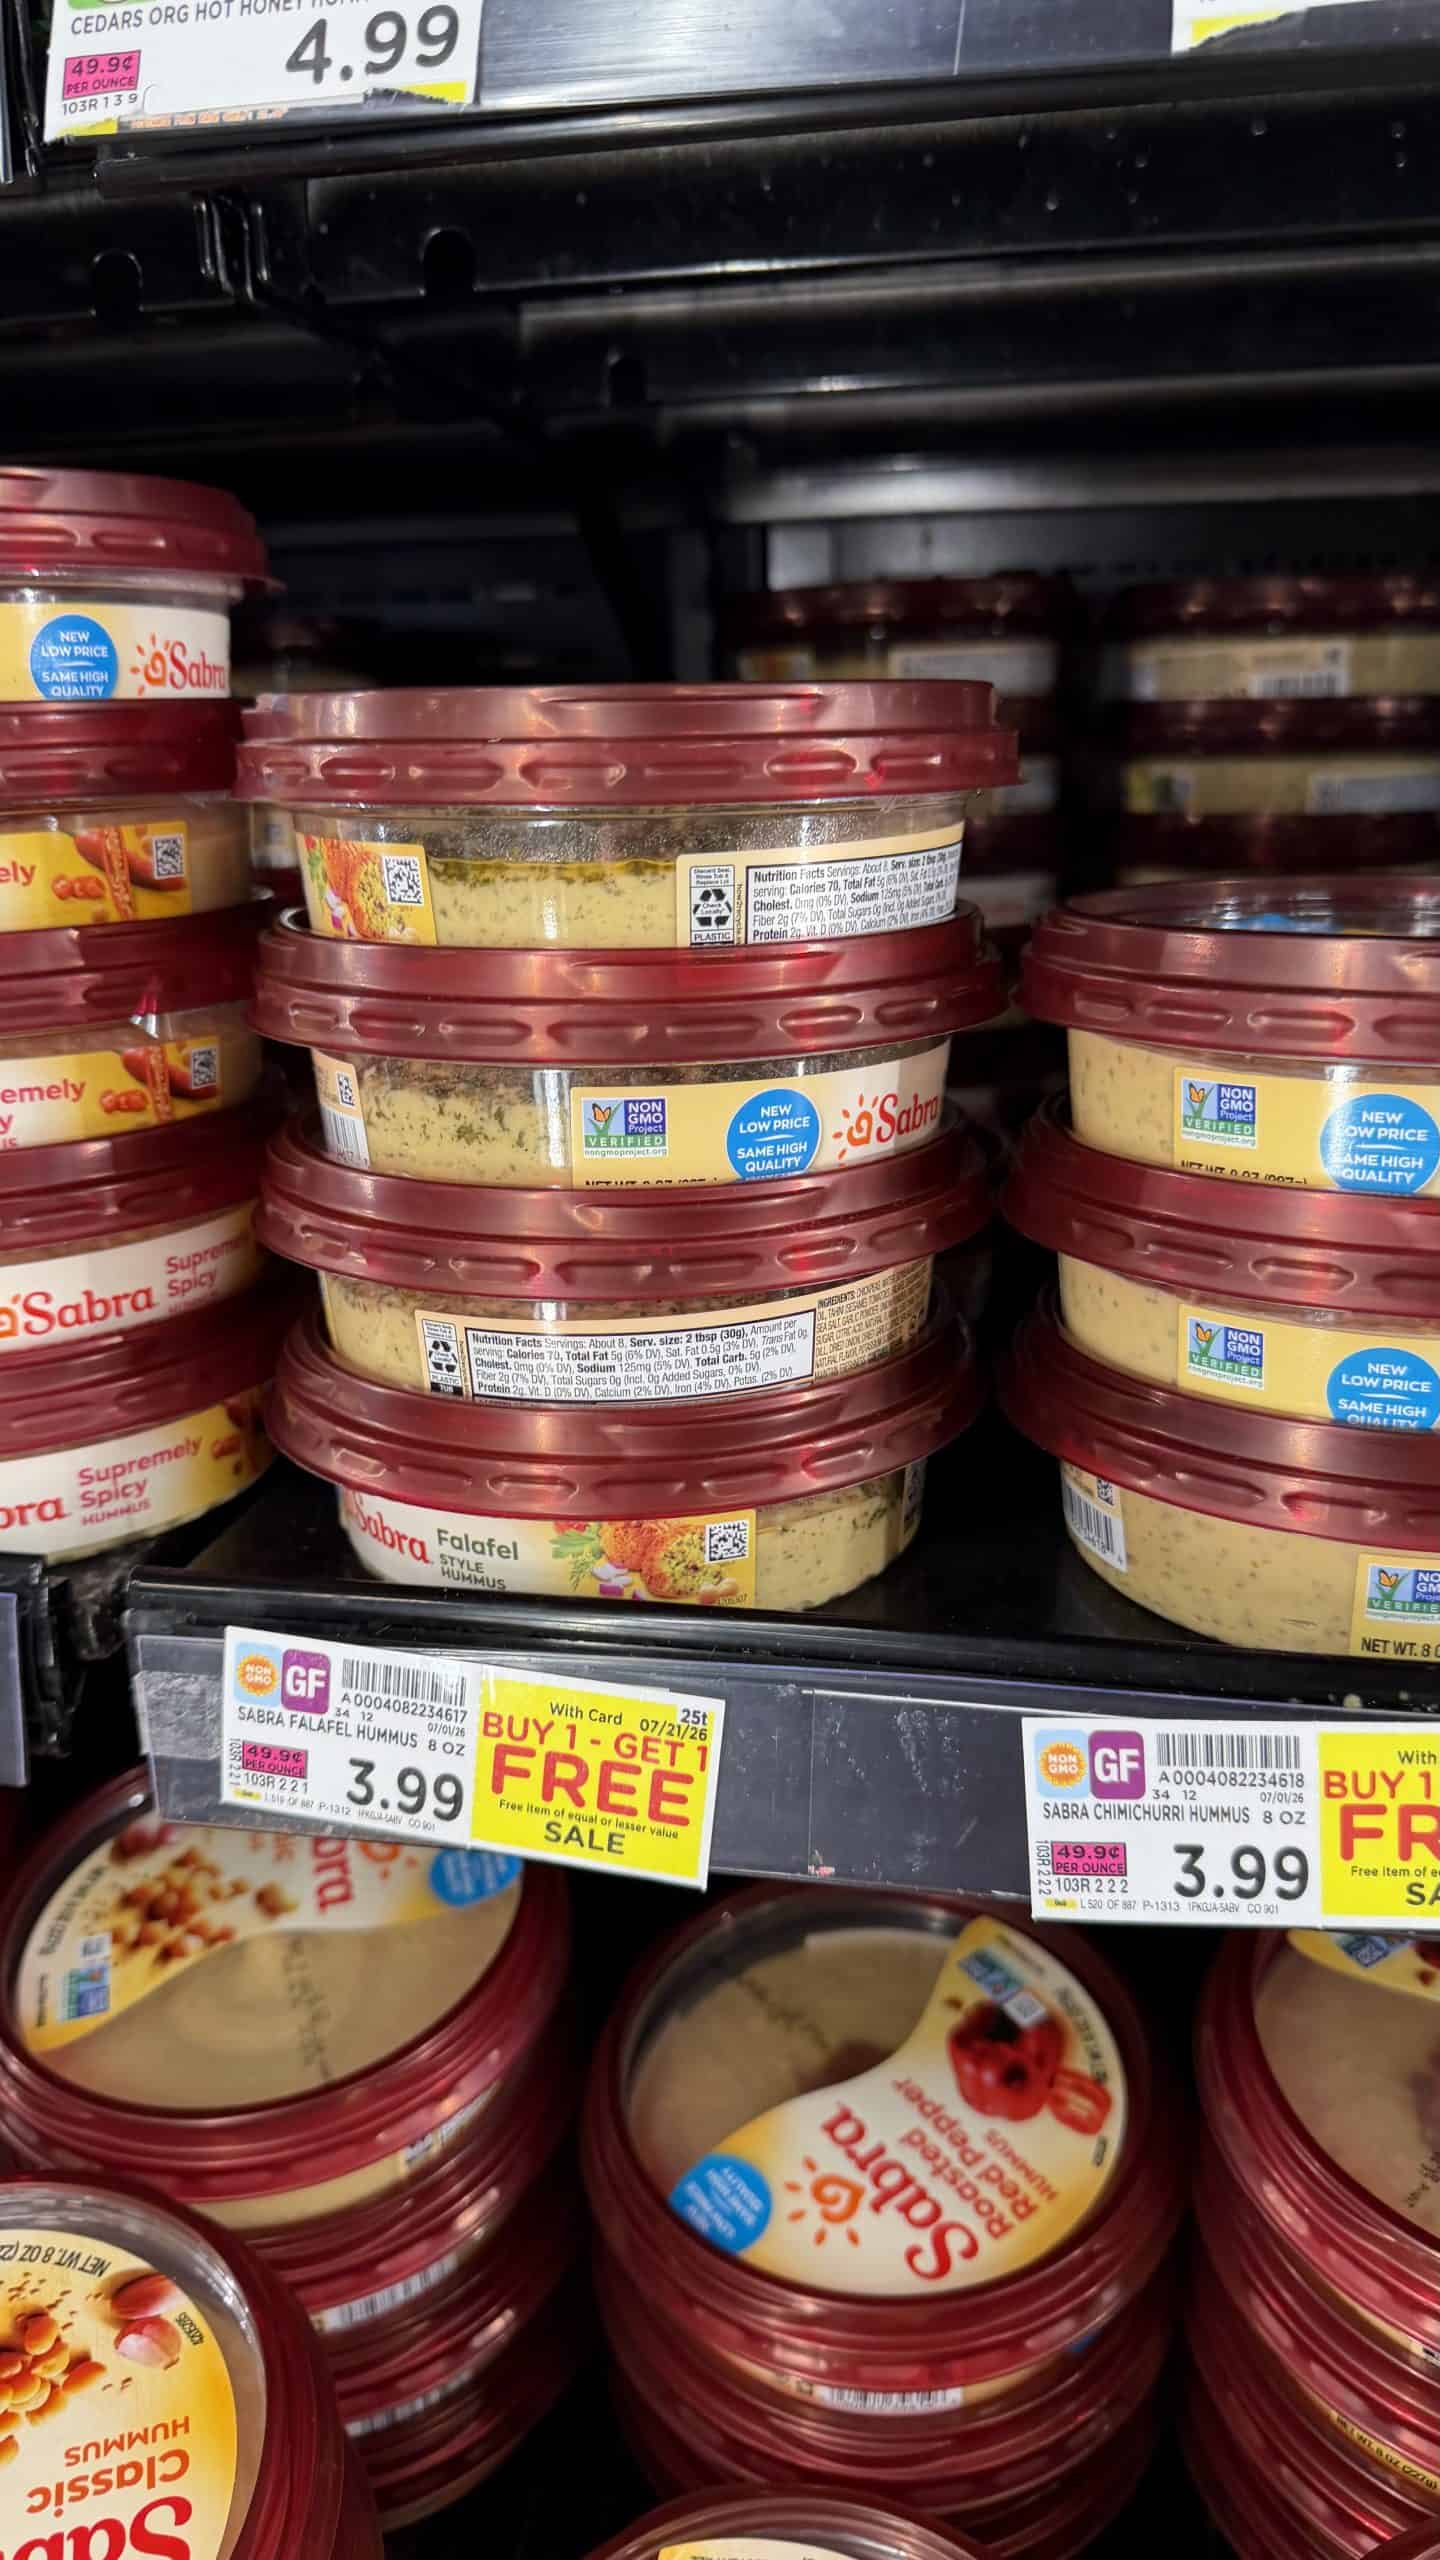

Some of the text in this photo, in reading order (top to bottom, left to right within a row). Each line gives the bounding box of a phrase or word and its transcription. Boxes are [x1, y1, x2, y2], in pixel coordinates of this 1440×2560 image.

[71, 10, 143, 35] CEDARS
[150, 5, 189, 25] ORG
[195, 0, 232, 21] HOT
[286, 5, 459, 85] 4.99
[72, 56, 133, 77] 49.9¢
[67, 76, 136, 95] PER OUNCE
[64, 98, 98, 115] 103R
[60, 631, 90, 643] NEW
[41, 646, 109, 657] LOW PRICE
[42, 671, 109, 683] SAME HIGH
[51, 685, 104, 697] QUALITY
[754, 871, 797, 883] Nutrition
[789, 882, 825, 896] Calories
[851, 891, 879, 904] Sodium
[753, 929, 788, 941] Protein
[1220, 1087, 1254, 1101] NON
[628, 1102, 662, 1112] NON
[760, 1104, 792, 1118] NEW
[1219, 1099, 1254, 1113] GMO
[628, 1113, 663, 1124] GMO
[739, 1116, 811, 1134] LOW PRICE
[1219, 1110, 1253, 1122] Project
[1362, 1111, 1403, 1124] NEW
[628, 1125, 663, 1135] Project
[1185, 1118, 1254, 1136] VERIFIED
[1377, 1127, 1429, 1142] PRICE
[589, 1135, 663, 1147] VERIFIED
[737, 1142, 808, 1160] SAME HIGH
[745, 1156, 802, 1173] QUALITY
[1381, 1154, 1424, 1169] HIGH
[1341, 1169, 1416, 1185] QUALITY
[22, 1287, 154, 1335] Sabra
[472, 1333, 542, 1348] Nutrition Facts
[1227, 1329, 1260, 1345] NON
[506, 1349, 608, 1361] Calories Total Fat
[1226, 1340, 1261, 1356] GMO
[577, 1357, 720, 1374] Sodium Total
[1191, 1354, 1261, 1378] VERIFIED
[1227, 1351, 1260, 1365] Project
[1367, 1362, 1409, 1376] NEW
[478, 1383, 511, 1394] Protein
[1341, 1374, 1432, 1393] LOW PRICE
[1338, 1398, 1426, 1418] SAME HIGH
[78, 1436, 203, 1486] Supremely
[80, 1478, 148, 1509] Spicy
[80, 1500, 152, 1526] HUMMUS
[352, 1492, 430, 1564] Sabra
[437, 1528, 519, 1561] Falafel
[440, 1553, 484, 1574] STYLE
[442, 1567, 507, 1592] HUMMUS
[1361, 1637, 1431, 1657] NET WT. 8
[245, 1663, 271, 1676] NON
[246, 1672, 272, 1684] GMO
[286, 1665, 326, 1698] GF
[361, 1712, 374, 1722] 12
[550, 1702, 708, 1742] With Card 07/21/26 25t
[238, 1706, 466, 1757] SABRA FALAFEL HUMMUS 8 OZ
[482, 1711, 708, 1772] BUY 1 GET 1
[246, 1744, 303, 1763] 49.9¢
[1048, 1754, 1077, 1764] NON
[1398, 1750, 1437, 1765] With
[244, 1758, 305, 1778] PER OUNCE
[1048, 1763, 1079, 1775] GMO
[1094, 1748, 1141, 1783] GF
[244, 1772, 275, 1790] 103R
[346, 1757, 464, 1821] 3.99
[491, 1743, 695, 1827] FREE
[1324, 1770, 1431, 1800] BUY 1
[1152, 1789, 1197, 1801] 34 12
[499, 1799, 679, 1840] Free item of equal or lesser value
[1043, 1802, 1306, 1825] SABRA CHIMICHURRI HUMMUS 8 OZ
[543, 1820, 625, 1855] SALE
[1339, 1803, 1440, 1862] FR
[1036, 1839, 1050, 1866] 103R
[1057, 1845, 1120, 1860] 49.9¢
[1055, 1862, 1125, 1874] PER OUNCE
[1173, 1843, 1309, 1901] 3.99
[1351, 1865, 1427, 1877] Free item of
[1055, 1878, 1128, 1893] 103R 2 2 2
[892, 2077, 985, 2167] Pepper
[986, 2128, 1059, 2203] HUMMUS
[821, 2103, 979, 2281] Sabra
[900, 2128, 1014, 2241] Roasted
[978, 2161, 1038, 2223] Red
[21, 2243, 39, 2262] OZ
[42, 2244, 53, 2263] 8
[56, 2247, 81, 2270] WT.
[80, 2252, 112, 2277] NET
[64, 2415, 190, 2467] HUMMUS
[26, 2448, 190, 2518] Classic
